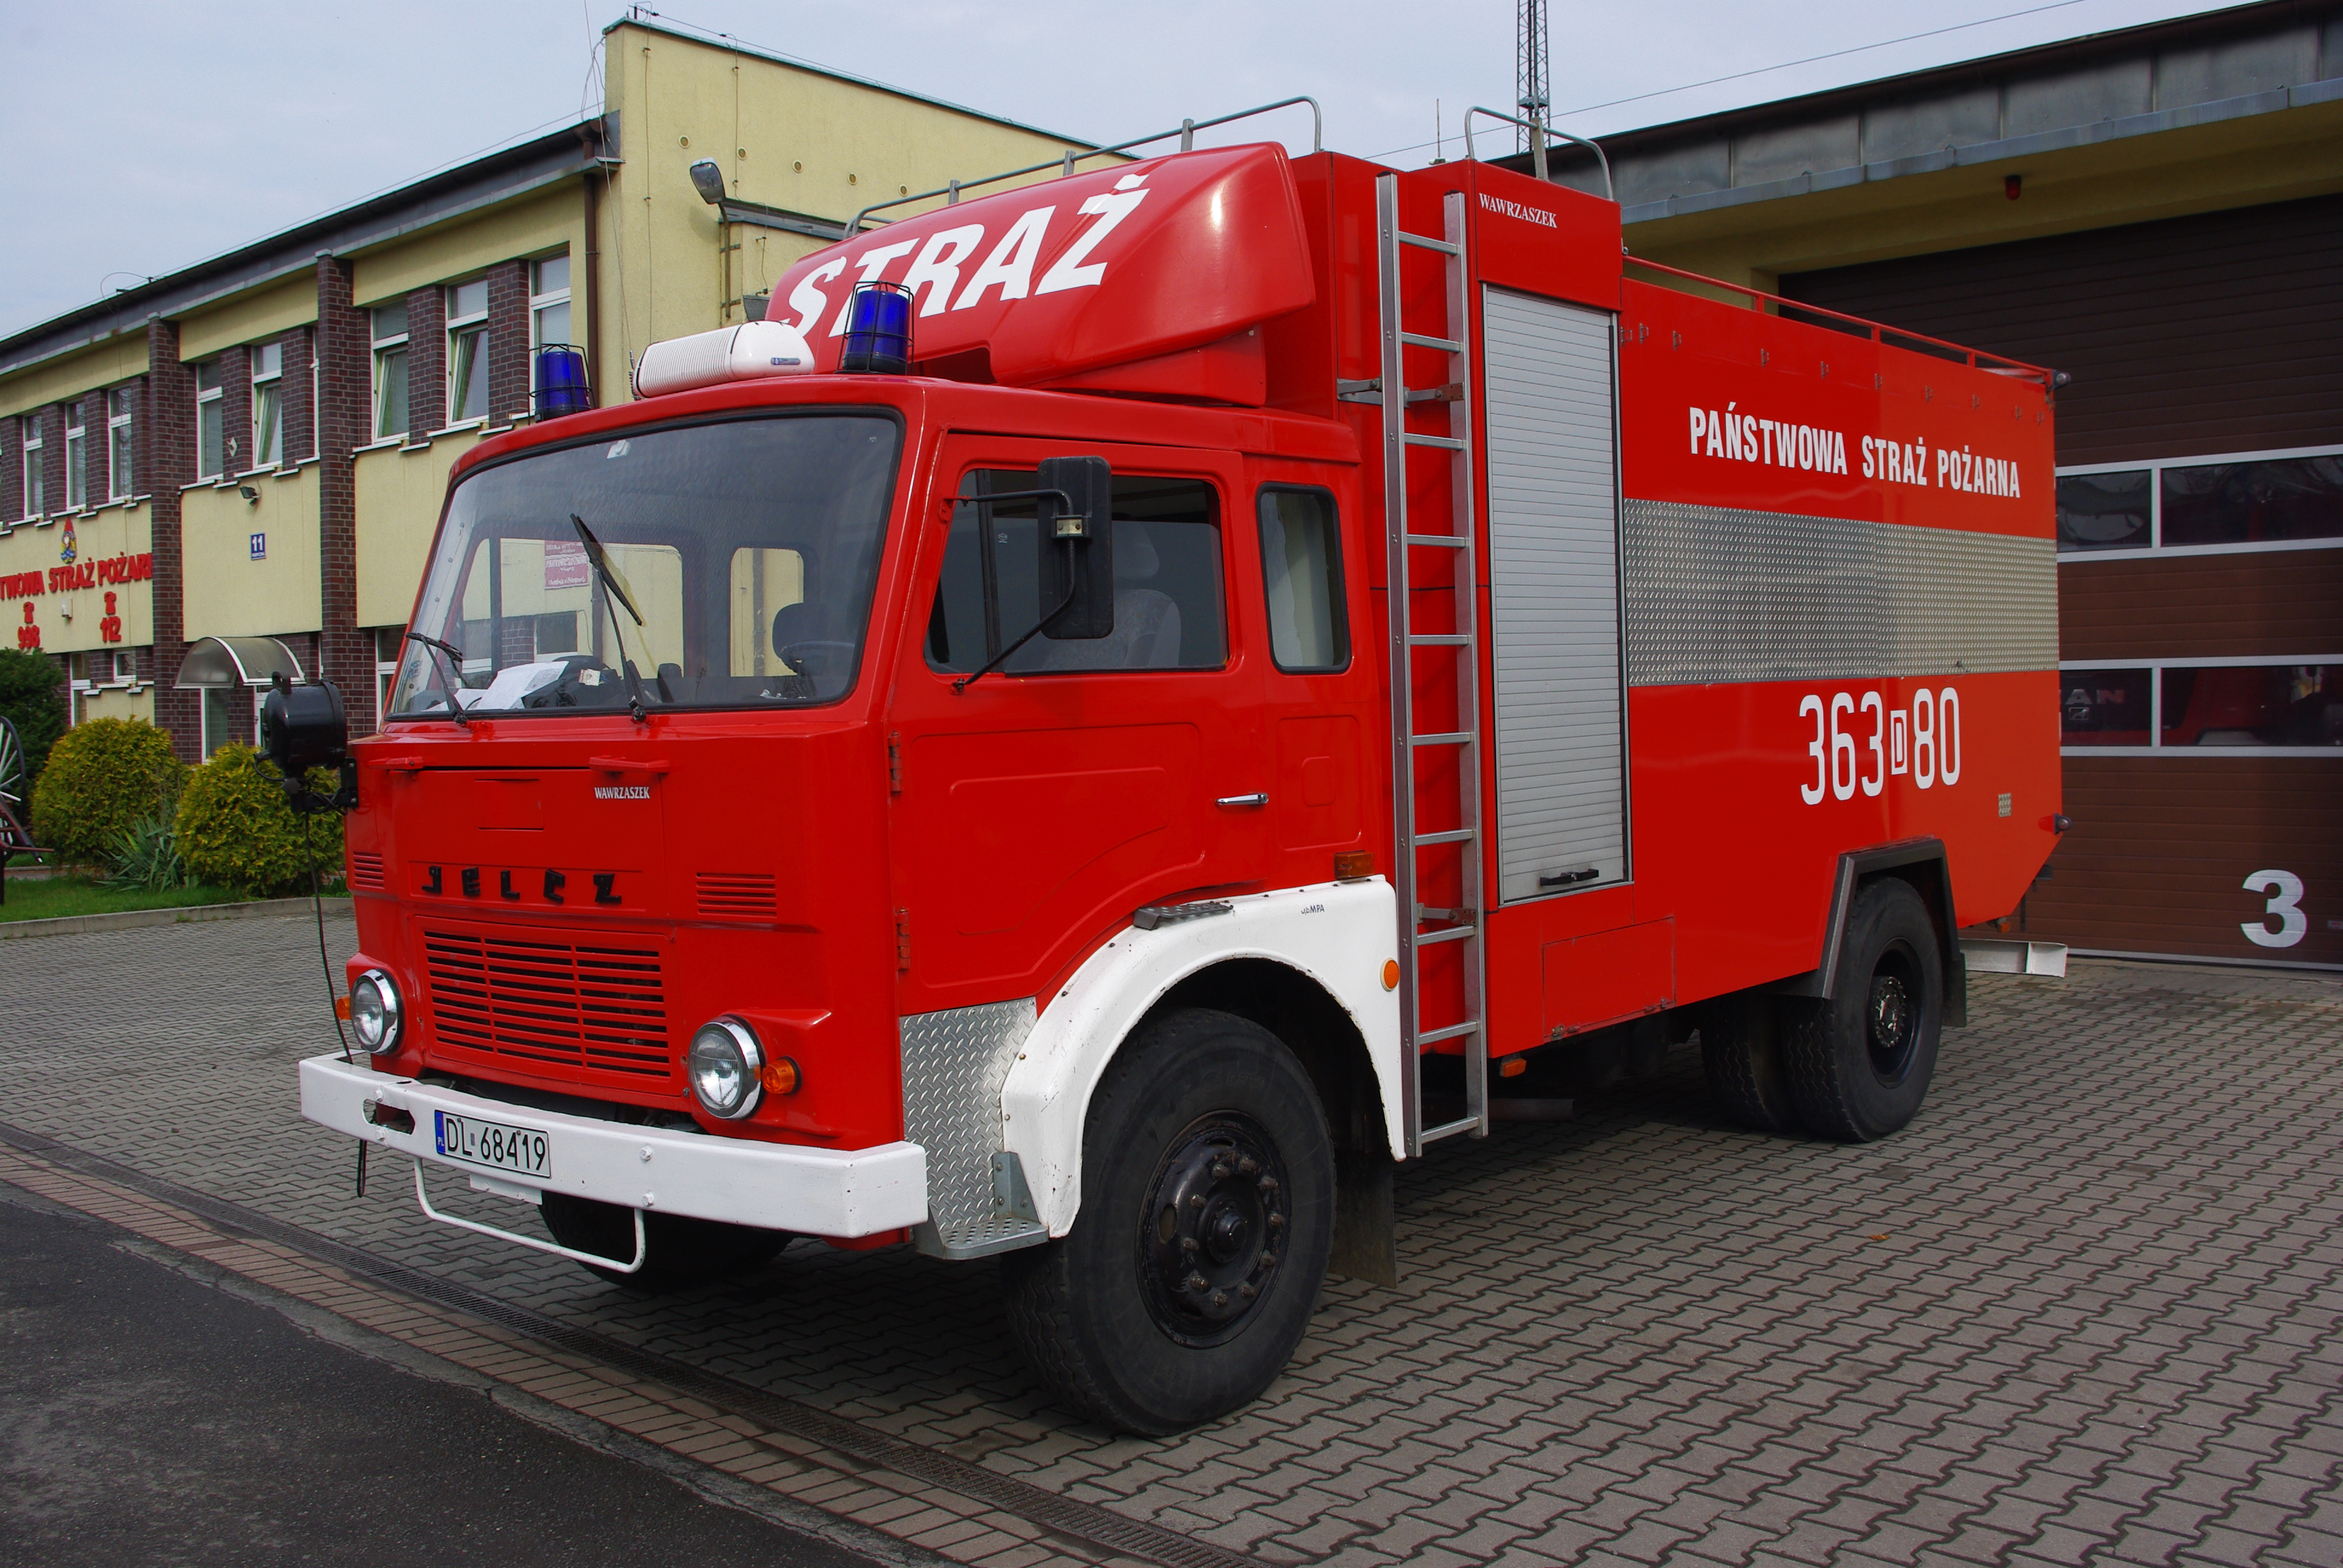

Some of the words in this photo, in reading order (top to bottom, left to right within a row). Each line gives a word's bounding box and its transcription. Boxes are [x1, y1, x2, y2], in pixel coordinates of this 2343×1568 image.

[1479, 192, 1557, 228] WAWRZASZEK
[779, 174, 1150, 337] STRAŻ
[1689, 402, 1847, 475] PAŃSTWOWA
[1862, 437, 1927, 486] STRAŻ
[1938, 445, 2020, 498] POŻARNA
[252, 535, 263, 551] 11
[49, 557, 95, 592] STRAŻ
[100, 616, 121, 642] 112
[594, 786, 650, 799] WAWRZASZEK
[422, 865, 621, 904] JELCZ
[2240, 869, 2307, 947] 3
[438, 1136, 445, 1146] PL
[446, 1117, 473, 1156] DL
[481, 1126, 546, 1171] 68419
